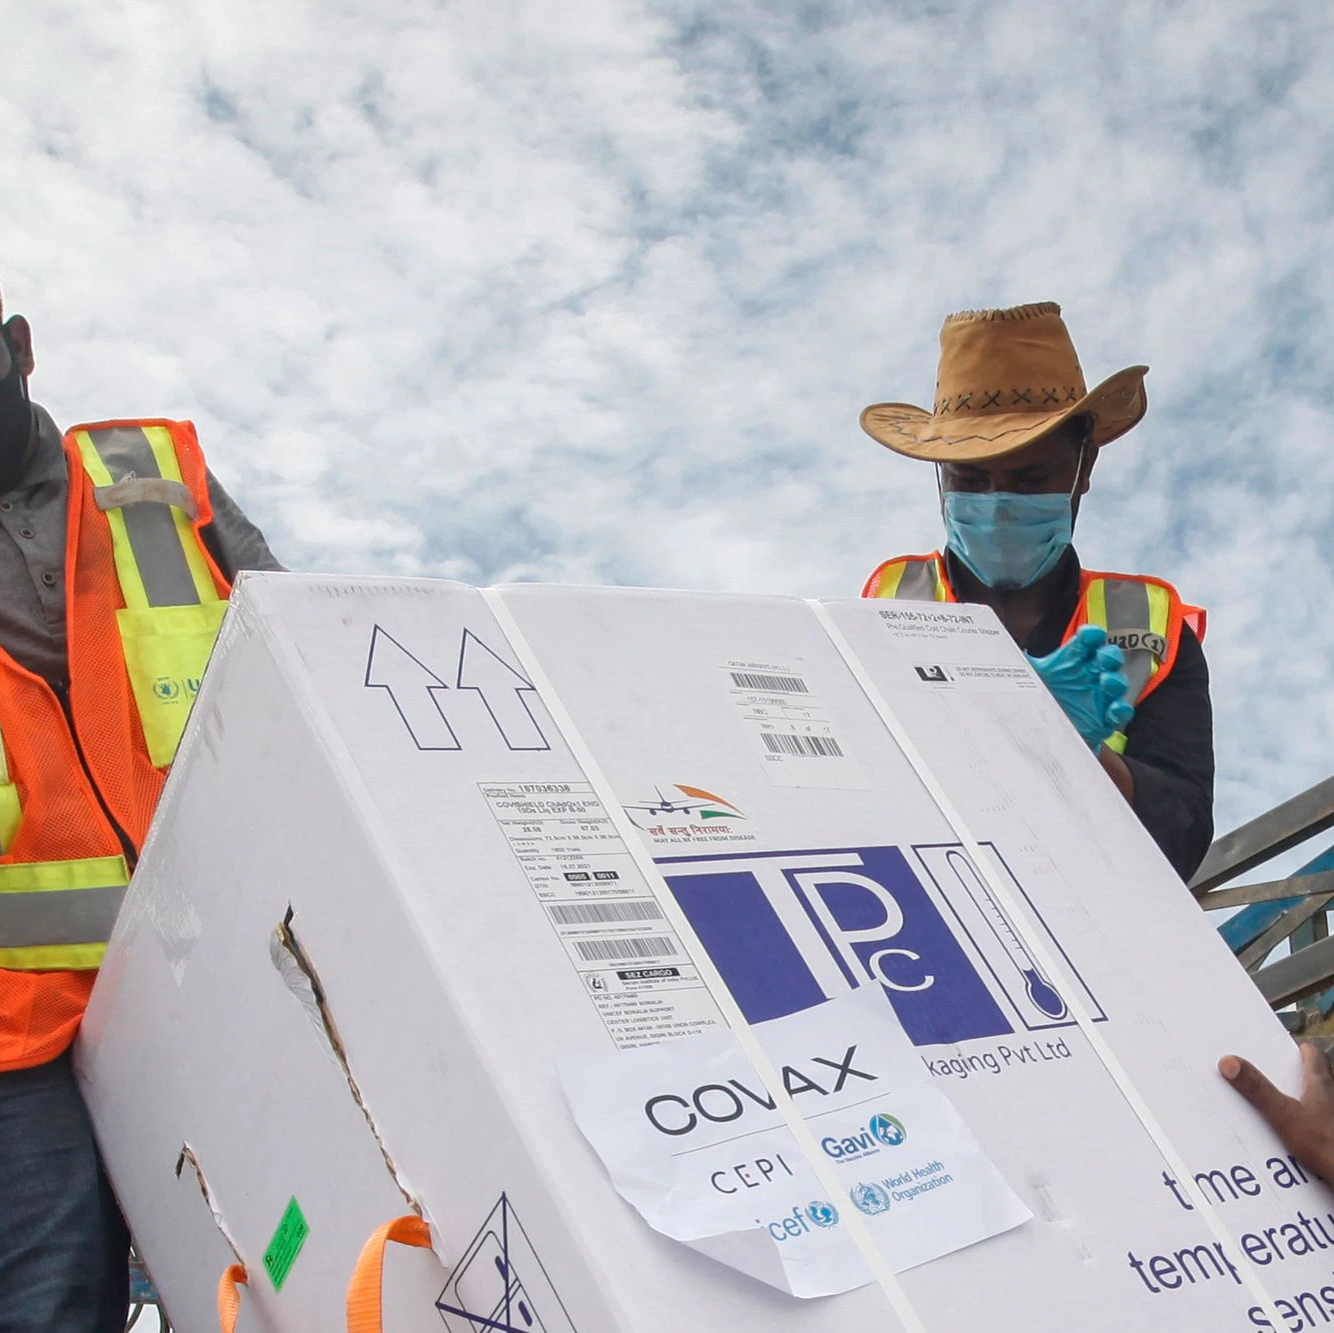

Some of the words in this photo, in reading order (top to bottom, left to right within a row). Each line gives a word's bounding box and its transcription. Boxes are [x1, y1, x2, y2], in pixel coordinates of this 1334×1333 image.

[921, 1053, 1001, 1079] kaging
[998, 1045, 1037, 1066] Pvt
[1034, 1037, 1072, 1061] Ltd
[644, 1044, 880, 1136] COVAX
[821, 1127, 876, 1158] Gavi
[711, 1153, 794, 1194] CEPI
[881, 1171, 913, 1189] World
[911, 1160, 945, 1180] Health
[891, 1174, 954, 1202] Organization
[1161, 1165, 1261, 1211] tme
